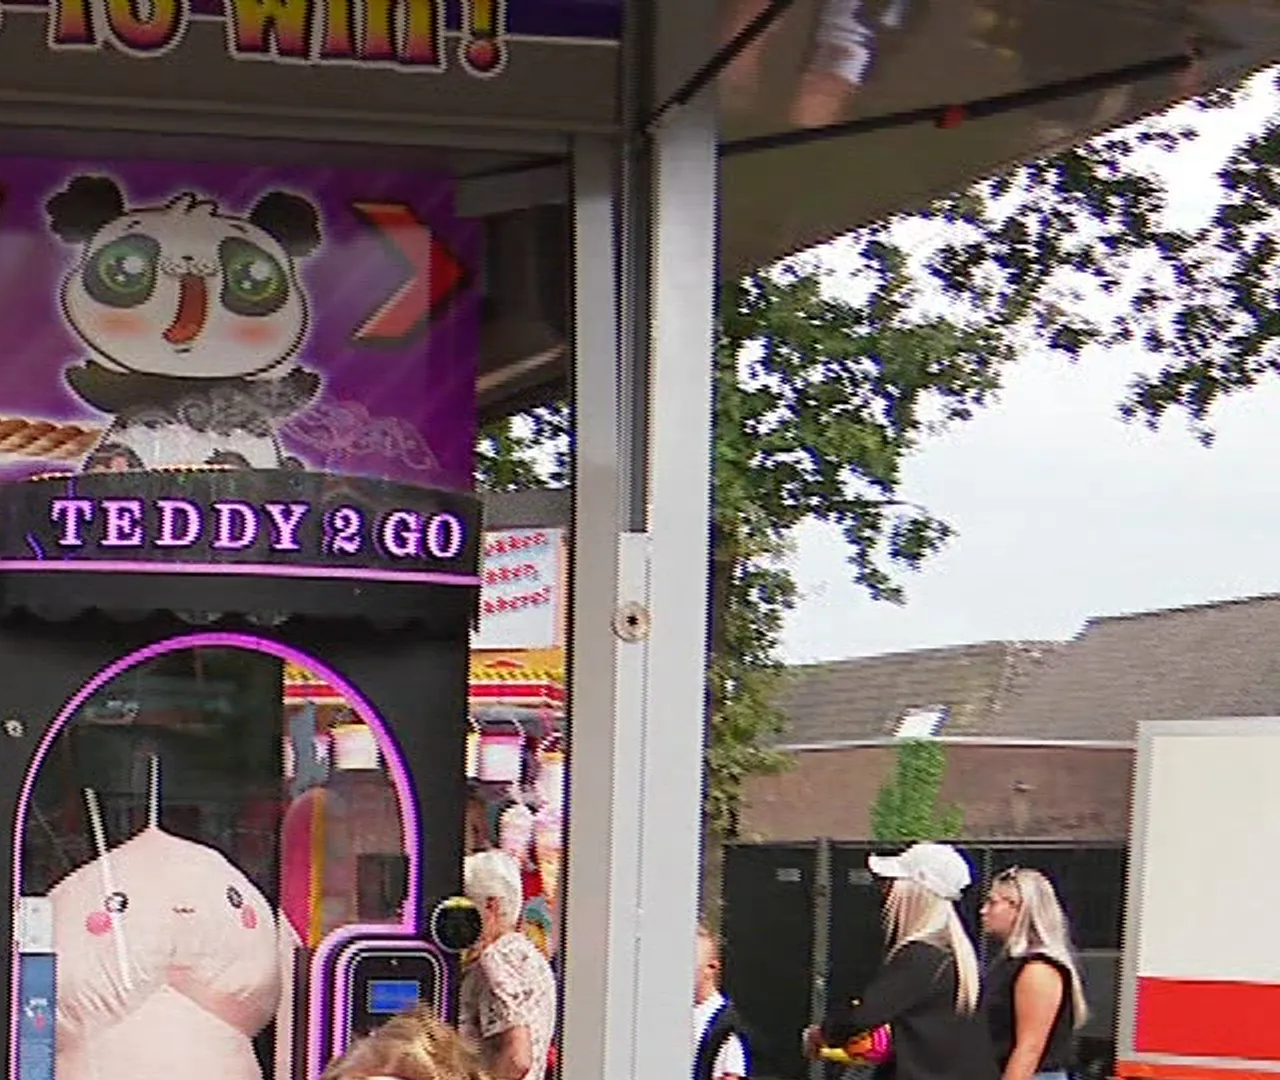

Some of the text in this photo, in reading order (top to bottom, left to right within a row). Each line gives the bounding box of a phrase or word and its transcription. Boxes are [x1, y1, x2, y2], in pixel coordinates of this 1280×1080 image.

[50, 499, 463, 558] TEDDY 2 GO
